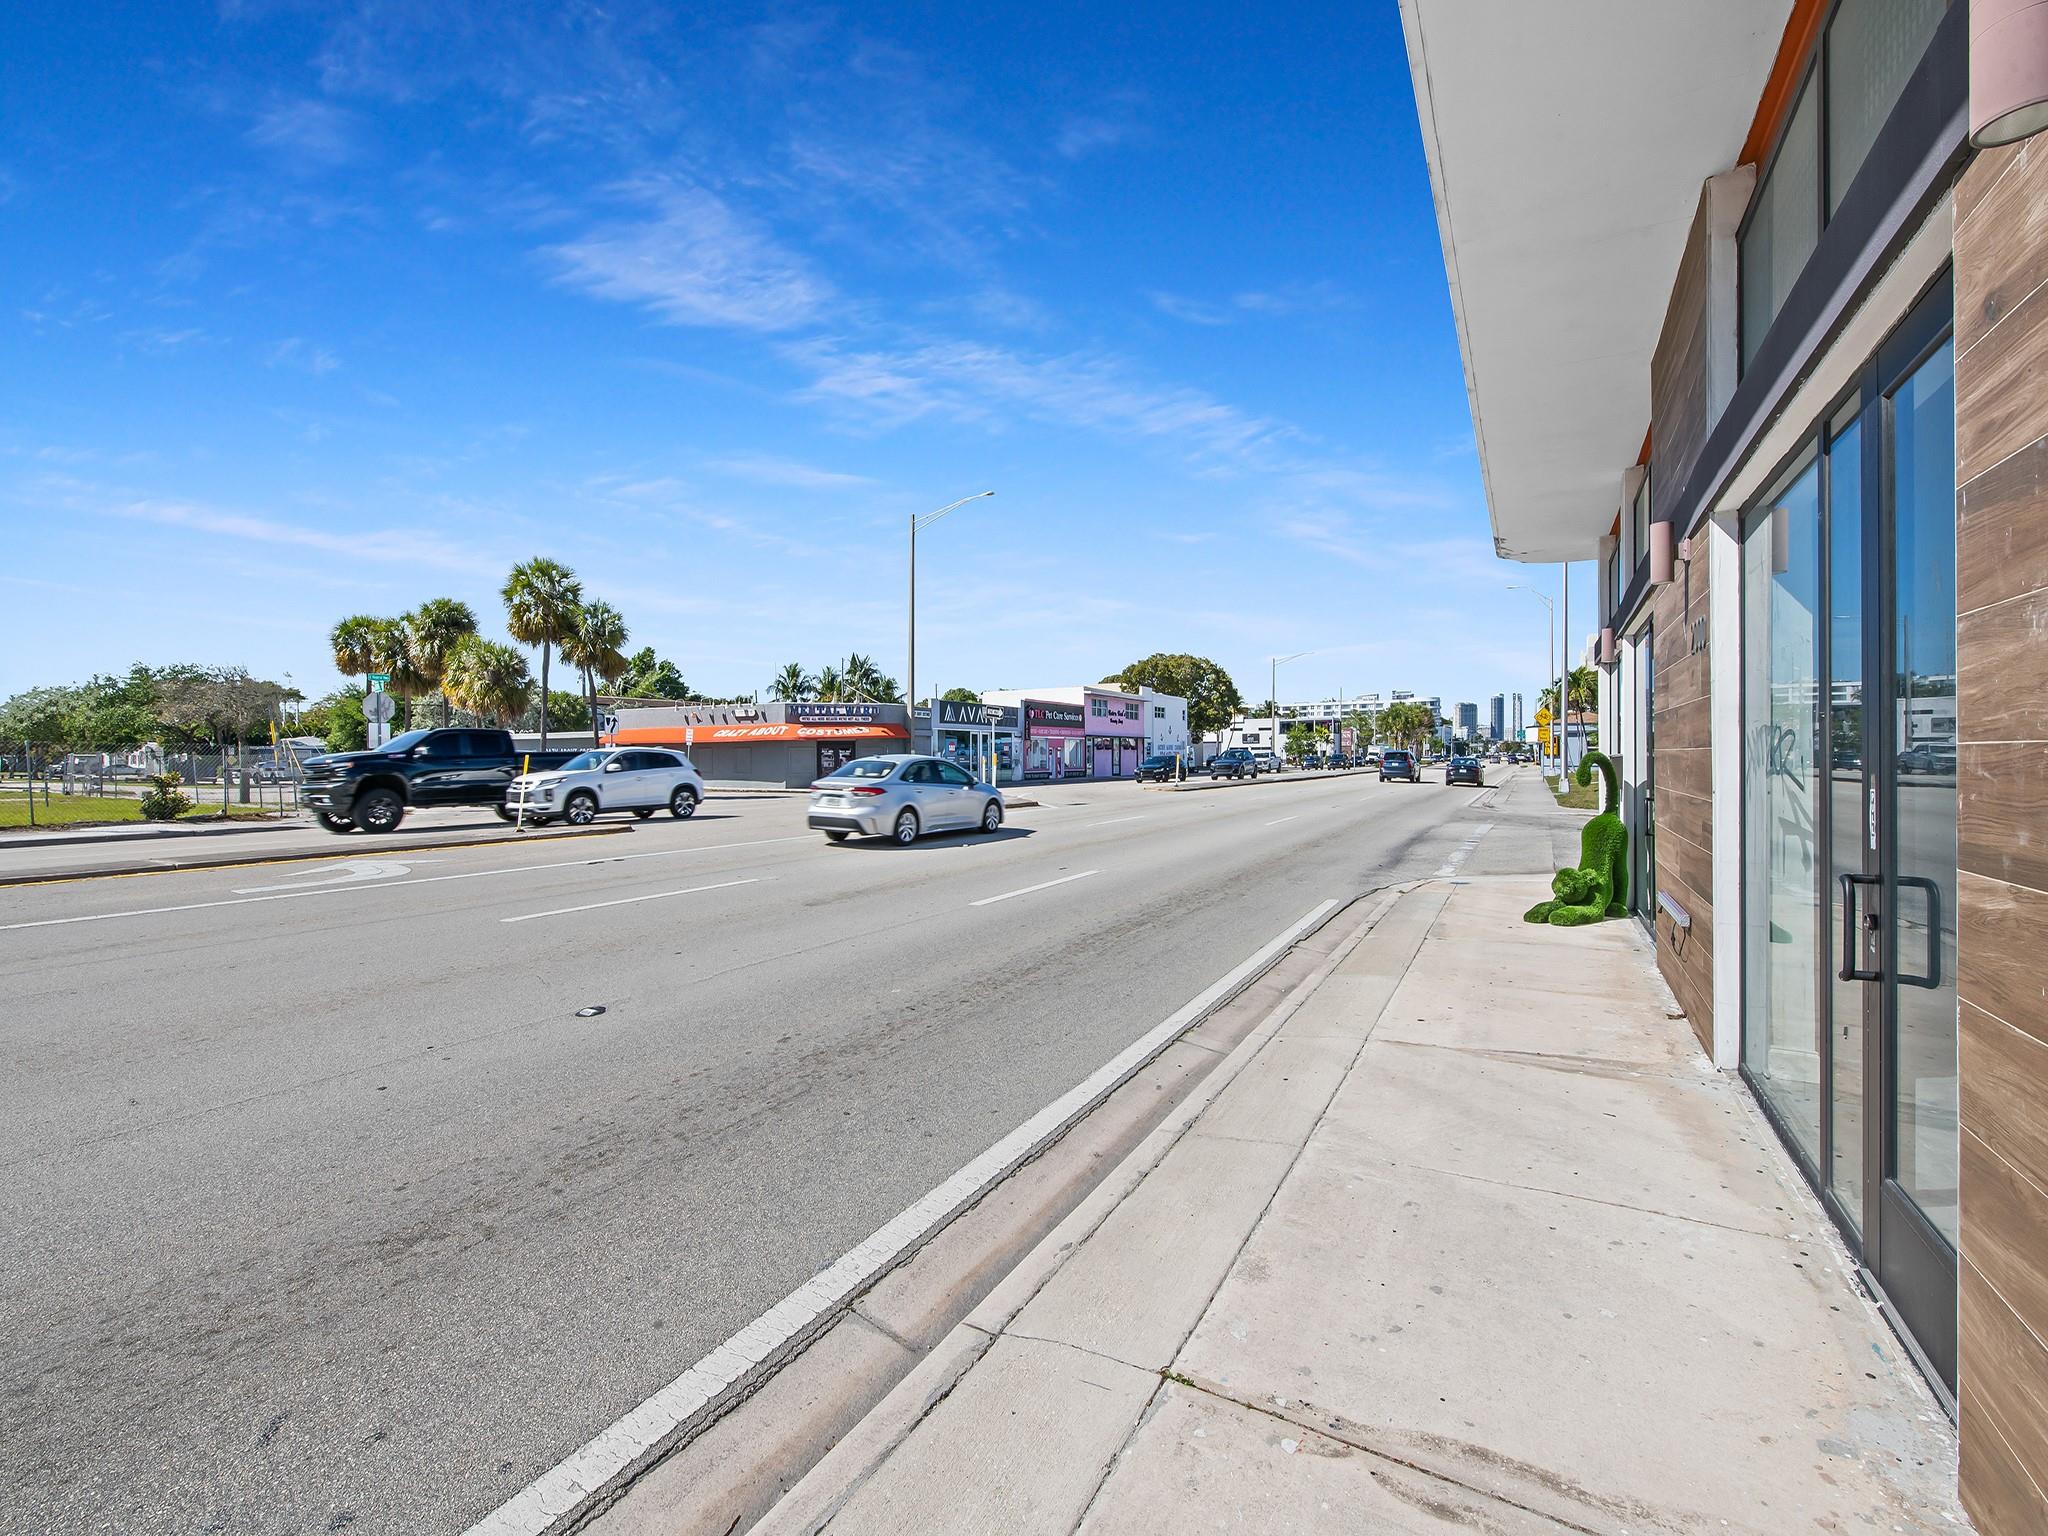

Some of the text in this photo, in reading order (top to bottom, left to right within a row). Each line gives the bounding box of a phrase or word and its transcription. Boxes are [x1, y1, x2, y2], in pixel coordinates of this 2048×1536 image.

[1053, 711, 1063, 720] Care
[713, 725, 870, 737] CRAZY ABOUT COSTUMES
